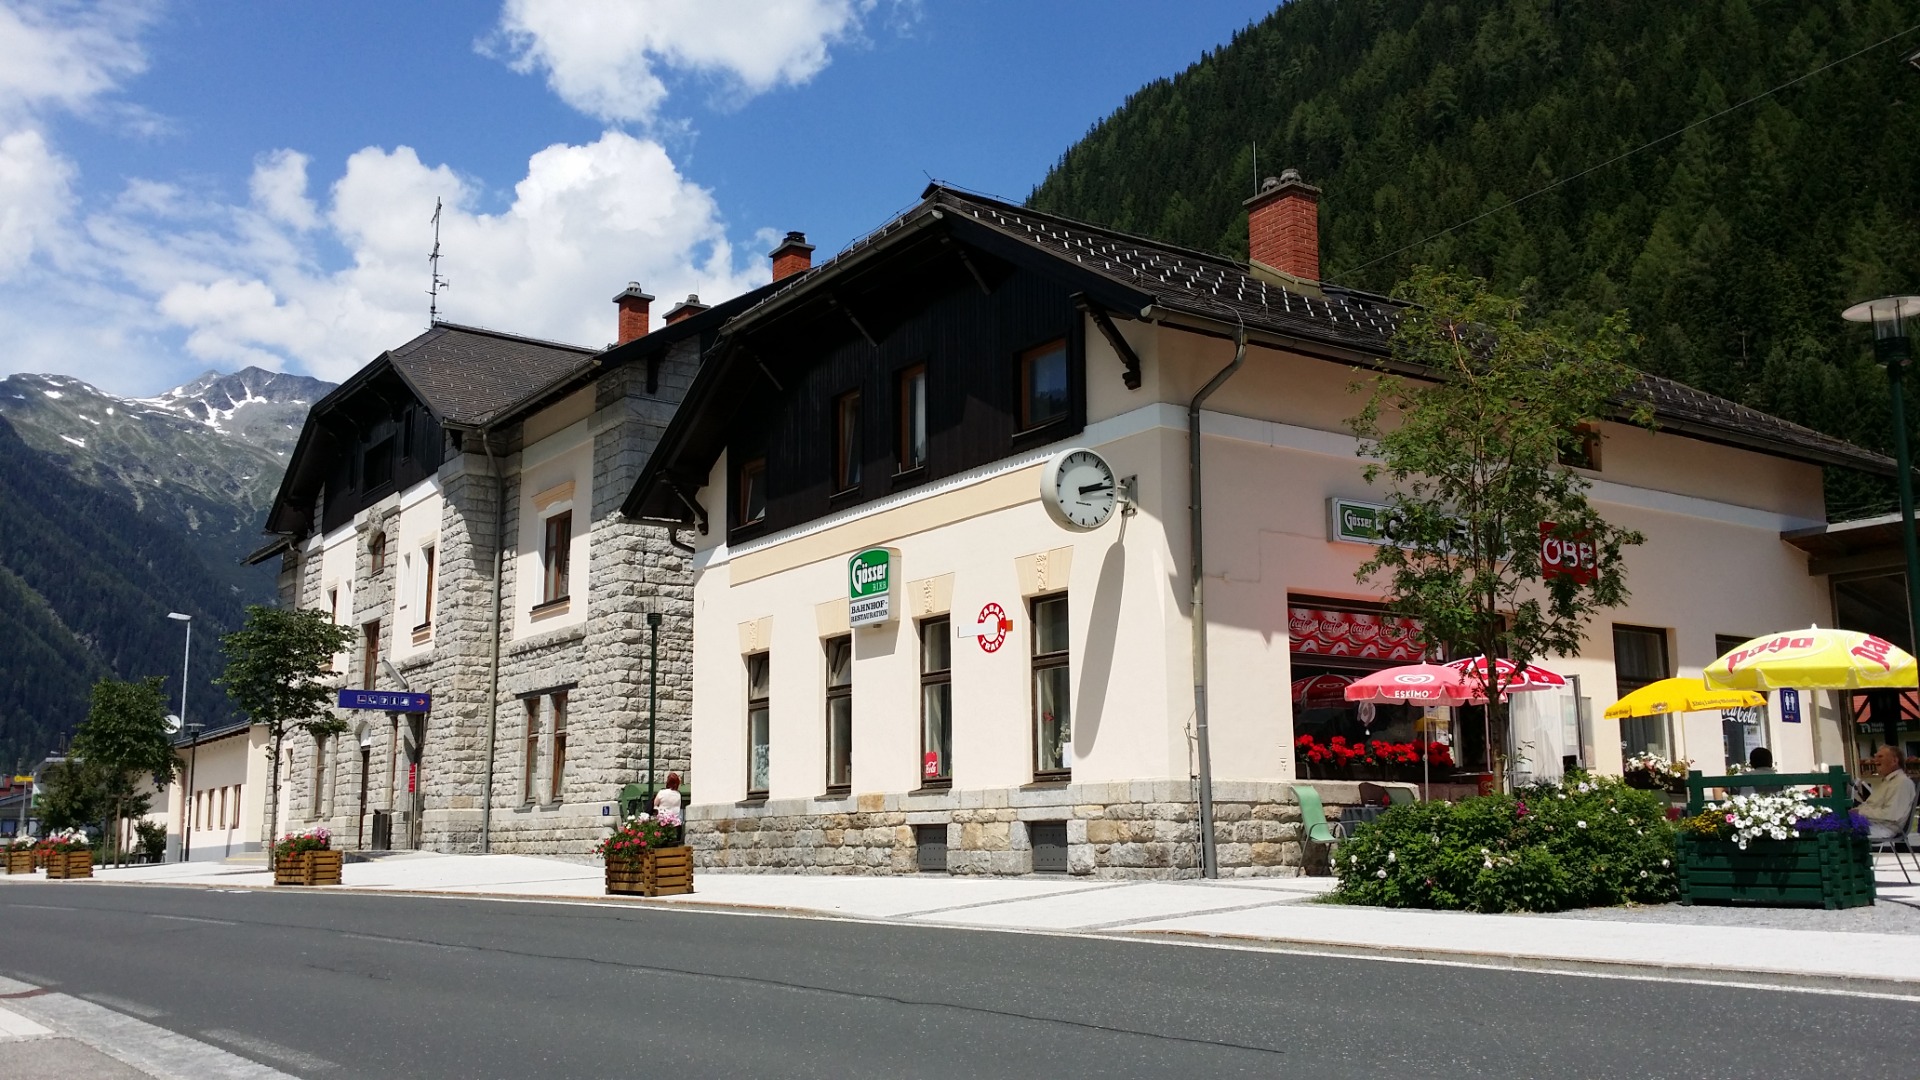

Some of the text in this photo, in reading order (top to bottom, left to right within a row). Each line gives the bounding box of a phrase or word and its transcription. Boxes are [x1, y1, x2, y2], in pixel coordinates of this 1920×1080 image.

[852, 559, 888, 594] Gösser
[872, 581, 887, 592] BIER
[851, 600, 888, 614] BAHNHOF-
[980, 604, 1005, 620] TABAK
[851, 609, 888, 622] RESTAURATION
[981, 628, 1005, 651] TRAFIK
[1394, 690, 1429, 698] ESKIMO
